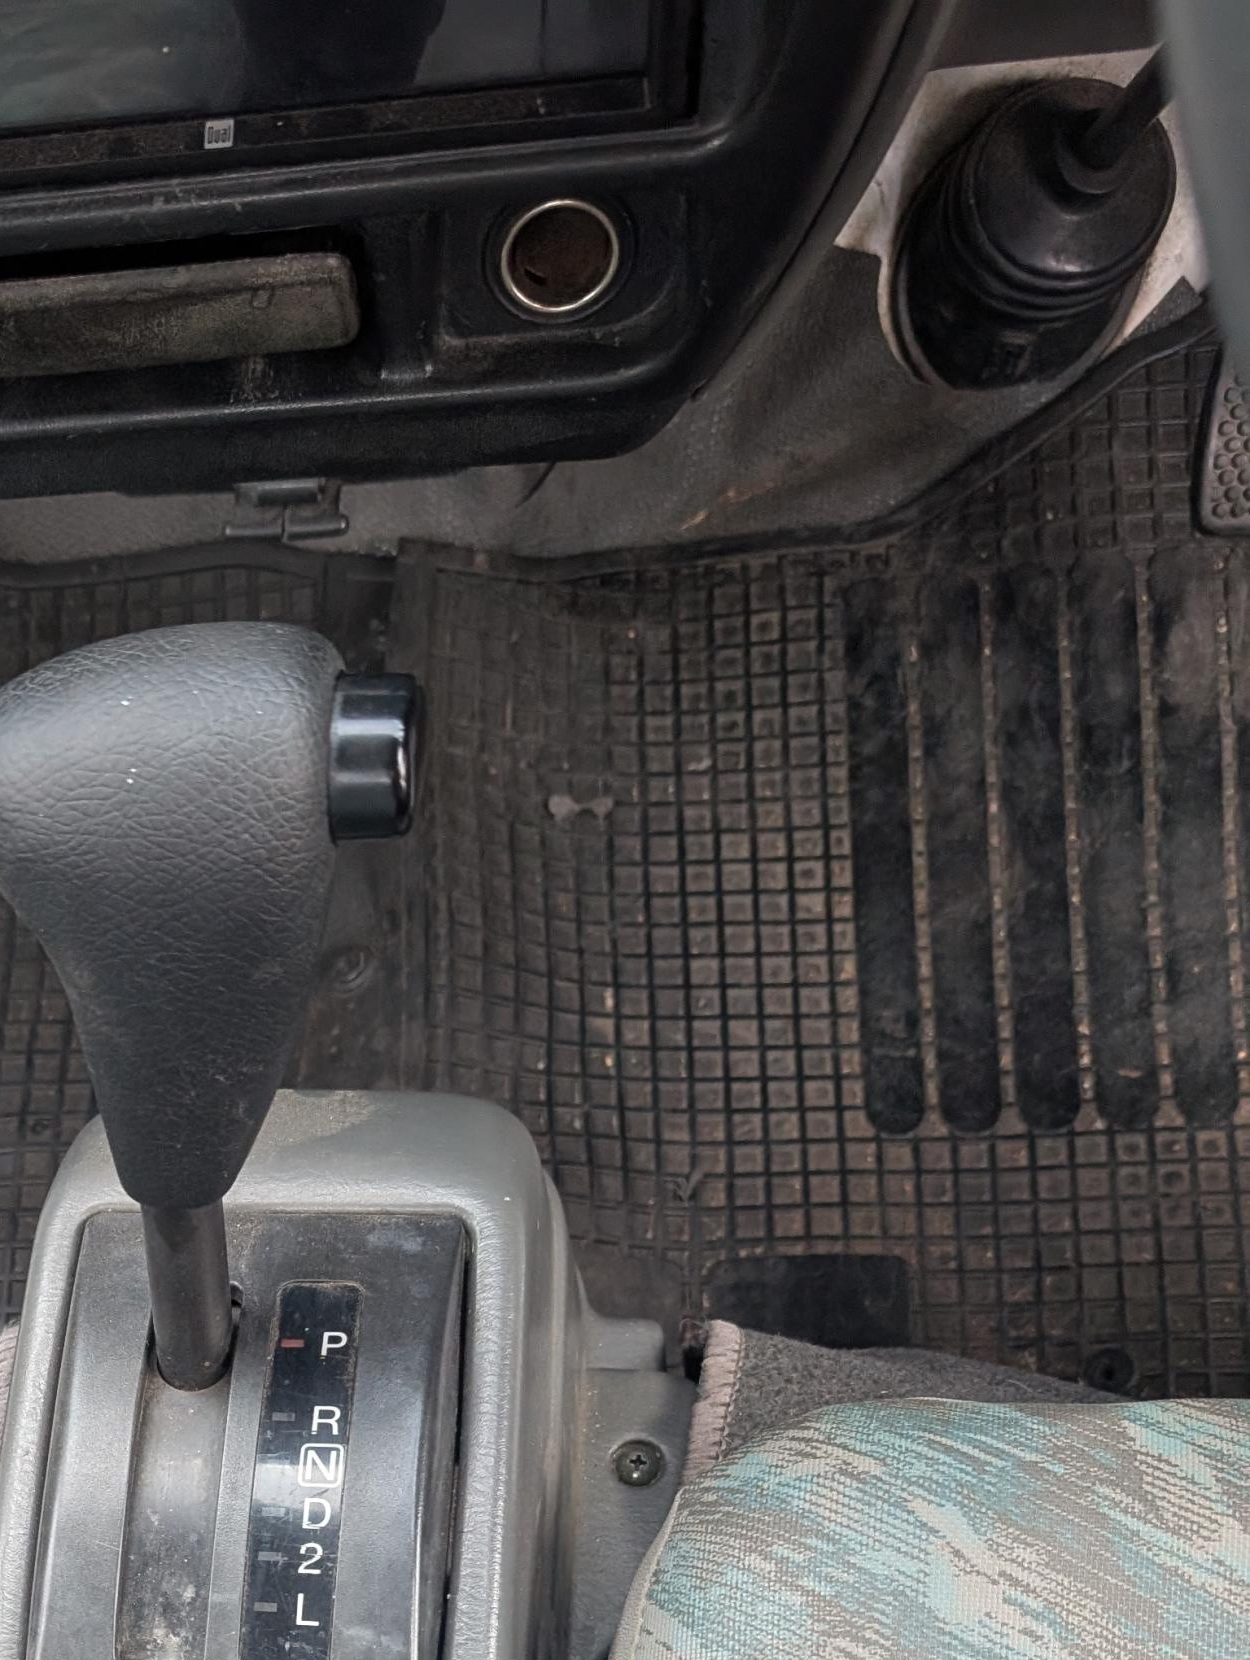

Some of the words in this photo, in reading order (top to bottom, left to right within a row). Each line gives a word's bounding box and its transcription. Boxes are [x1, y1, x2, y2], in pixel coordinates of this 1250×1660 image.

[320, 1331, 348, 1357] P
[311, 1405, 341, 1435] R
[305, 1449, 338, 1482] N
[302, 1498, 331, 1530] D
[297, 1543, 324, 1575] 2
[295, 1593, 320, 1627] L
